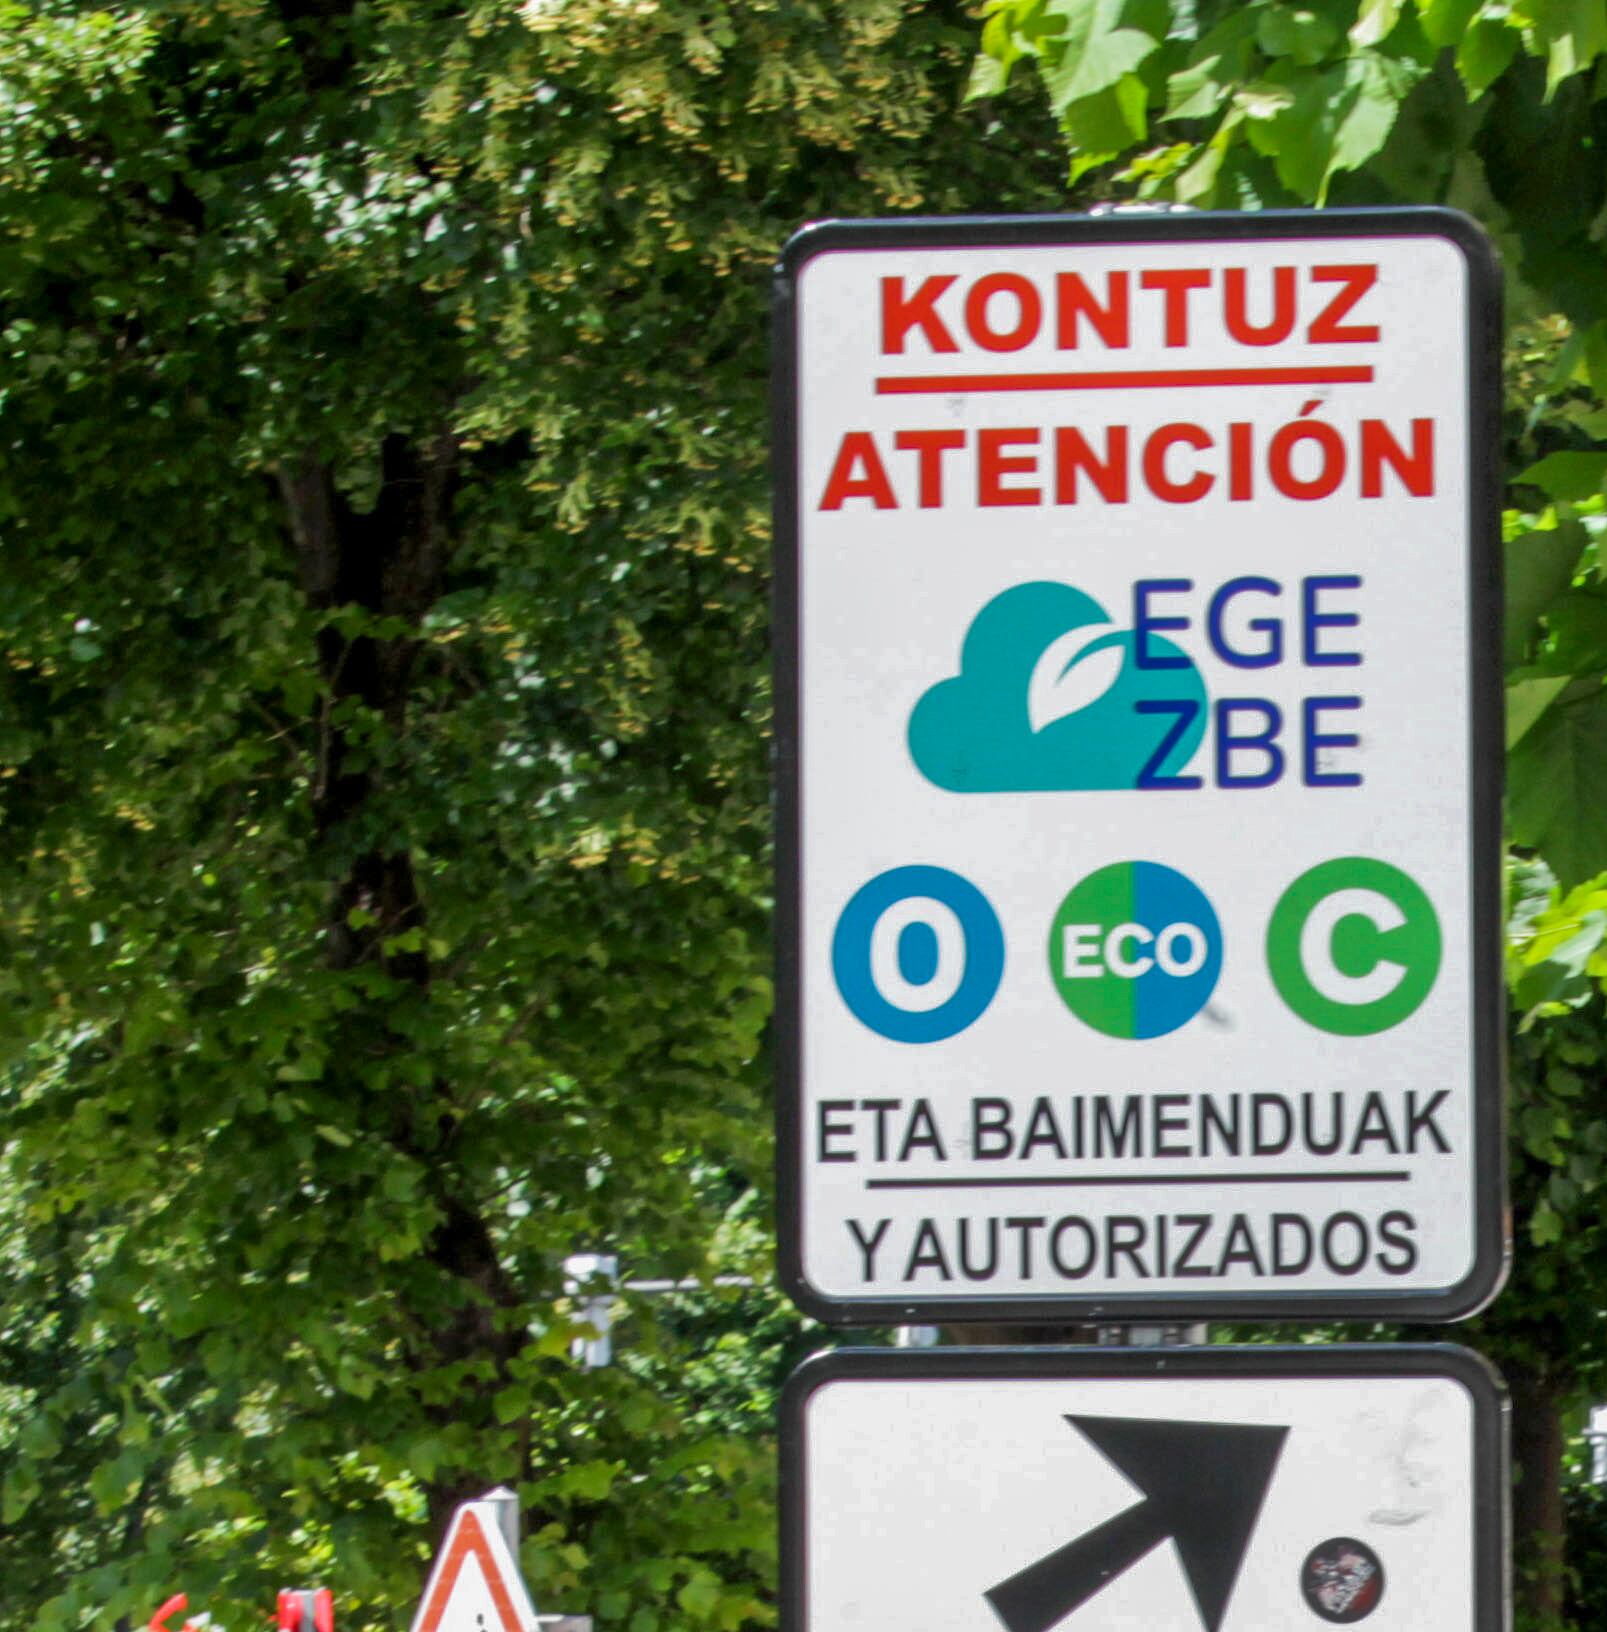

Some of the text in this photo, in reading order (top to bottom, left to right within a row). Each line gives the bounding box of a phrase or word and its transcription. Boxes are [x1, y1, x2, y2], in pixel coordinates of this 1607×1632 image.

[881, 264, 1380, 355] KONTUZ
[819, 400, 1435, 511] ATENCIÓN
[1133, 576, 1362, 671] EGE
[1133, 696, 1362, 790] ZBE
[1062, 923, 1208, 979] ECO
[1299, 889, 1409, 1007] C
[818, 1089, 1451, 1163] ETA BAIMENDUAK
[847, 1210, 1418, 1282] Y AUTORIZADOS
